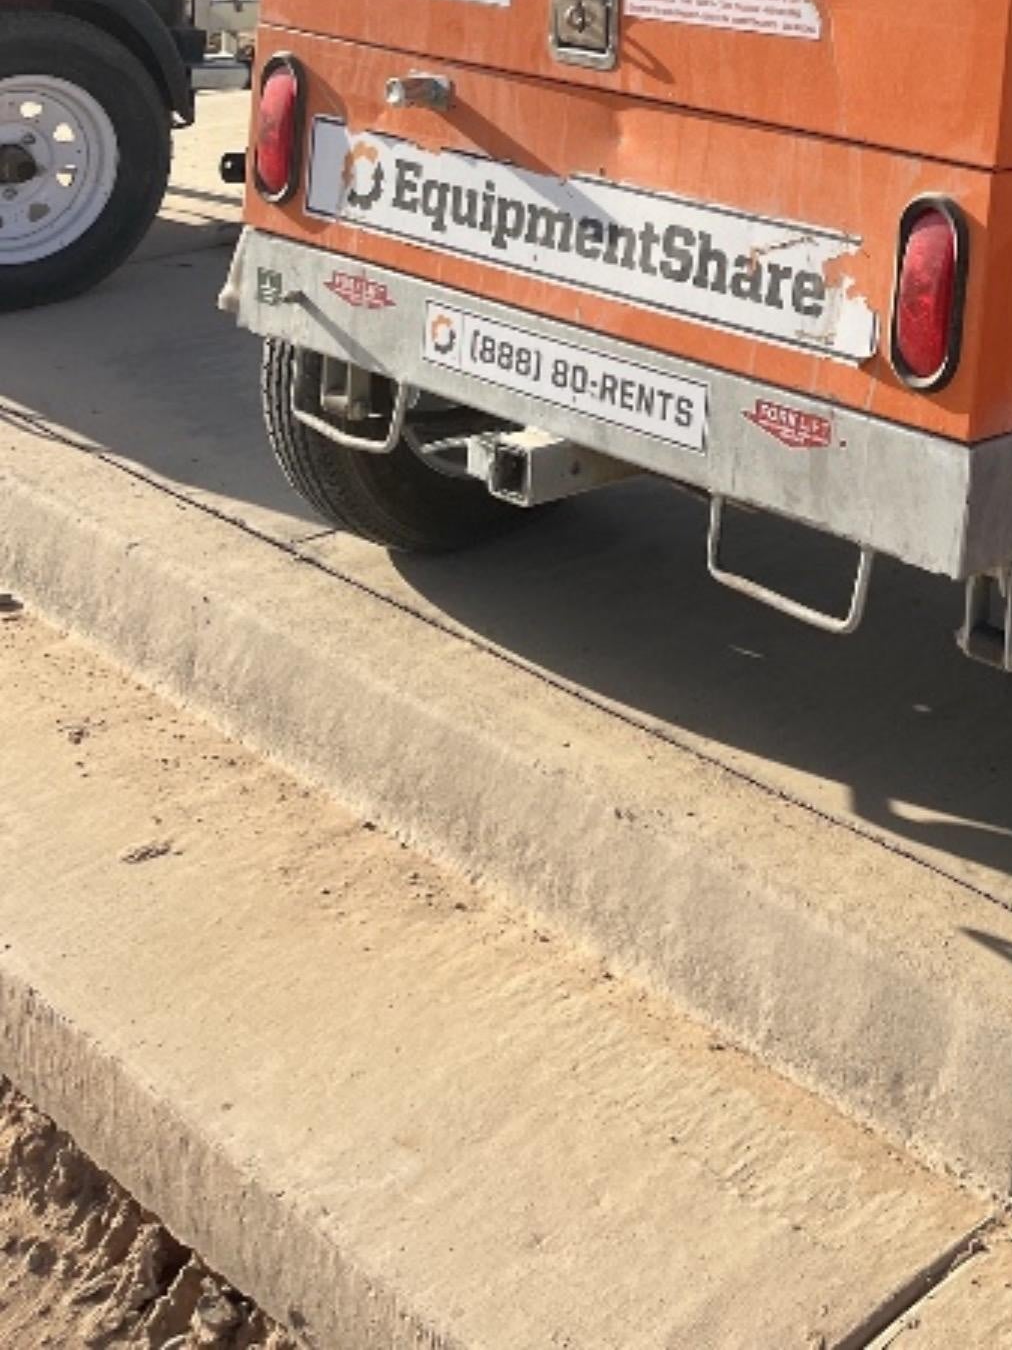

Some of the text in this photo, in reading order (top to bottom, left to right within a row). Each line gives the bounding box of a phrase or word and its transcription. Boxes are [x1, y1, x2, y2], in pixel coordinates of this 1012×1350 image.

[392, 158, 826, 318] EquipmentShare
[469, 330, 693, 427] (888) 80-RENTS
